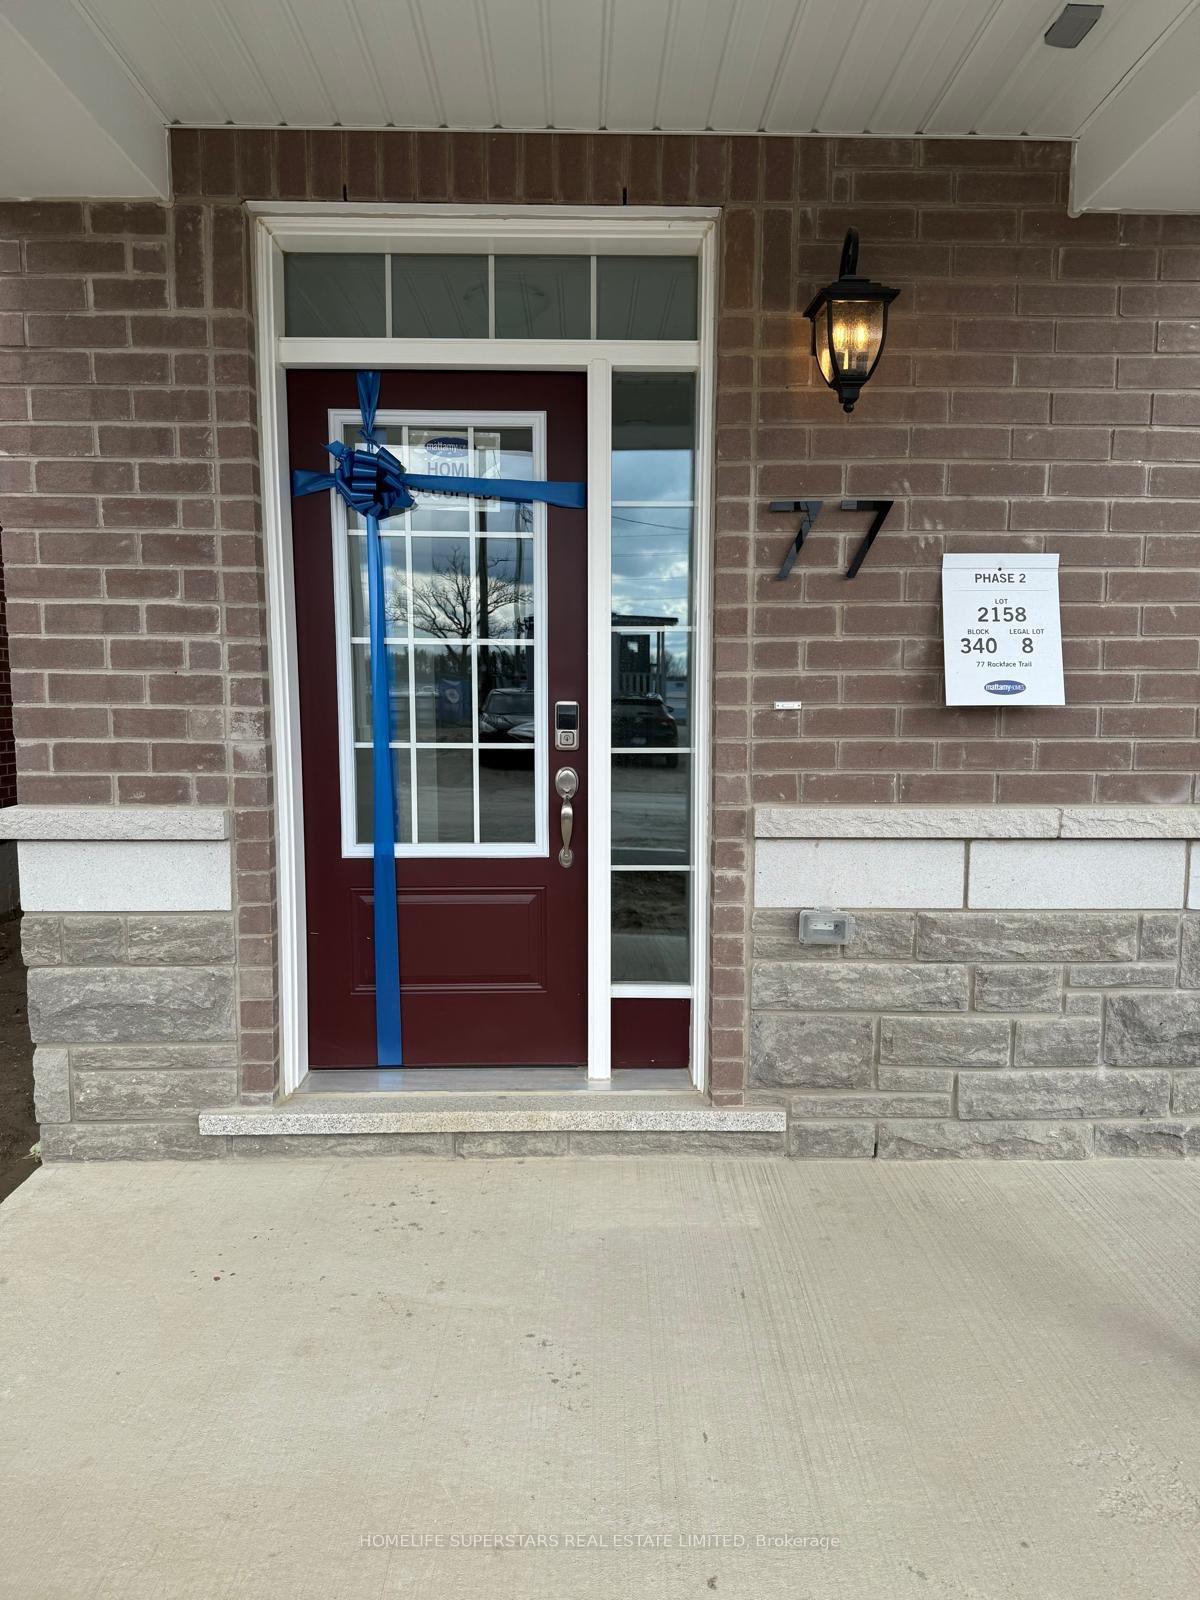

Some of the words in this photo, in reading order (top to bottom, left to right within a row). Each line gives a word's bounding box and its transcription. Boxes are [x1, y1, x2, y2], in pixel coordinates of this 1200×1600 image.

[428, 462, 469, 477] HOM
[769, 500, 894, 581] 77
[974, 573, 1015, 584] PHASE
[1019, 573, 1026, 584] 2
[977, 606, 1027, 623] 2158
[960, 637, 998, 654] 340
[1021, 637, 1034, 654] 8
[987, 660, 1017, 668] Rockface
[1018, 660, 1032, 668] Trail
